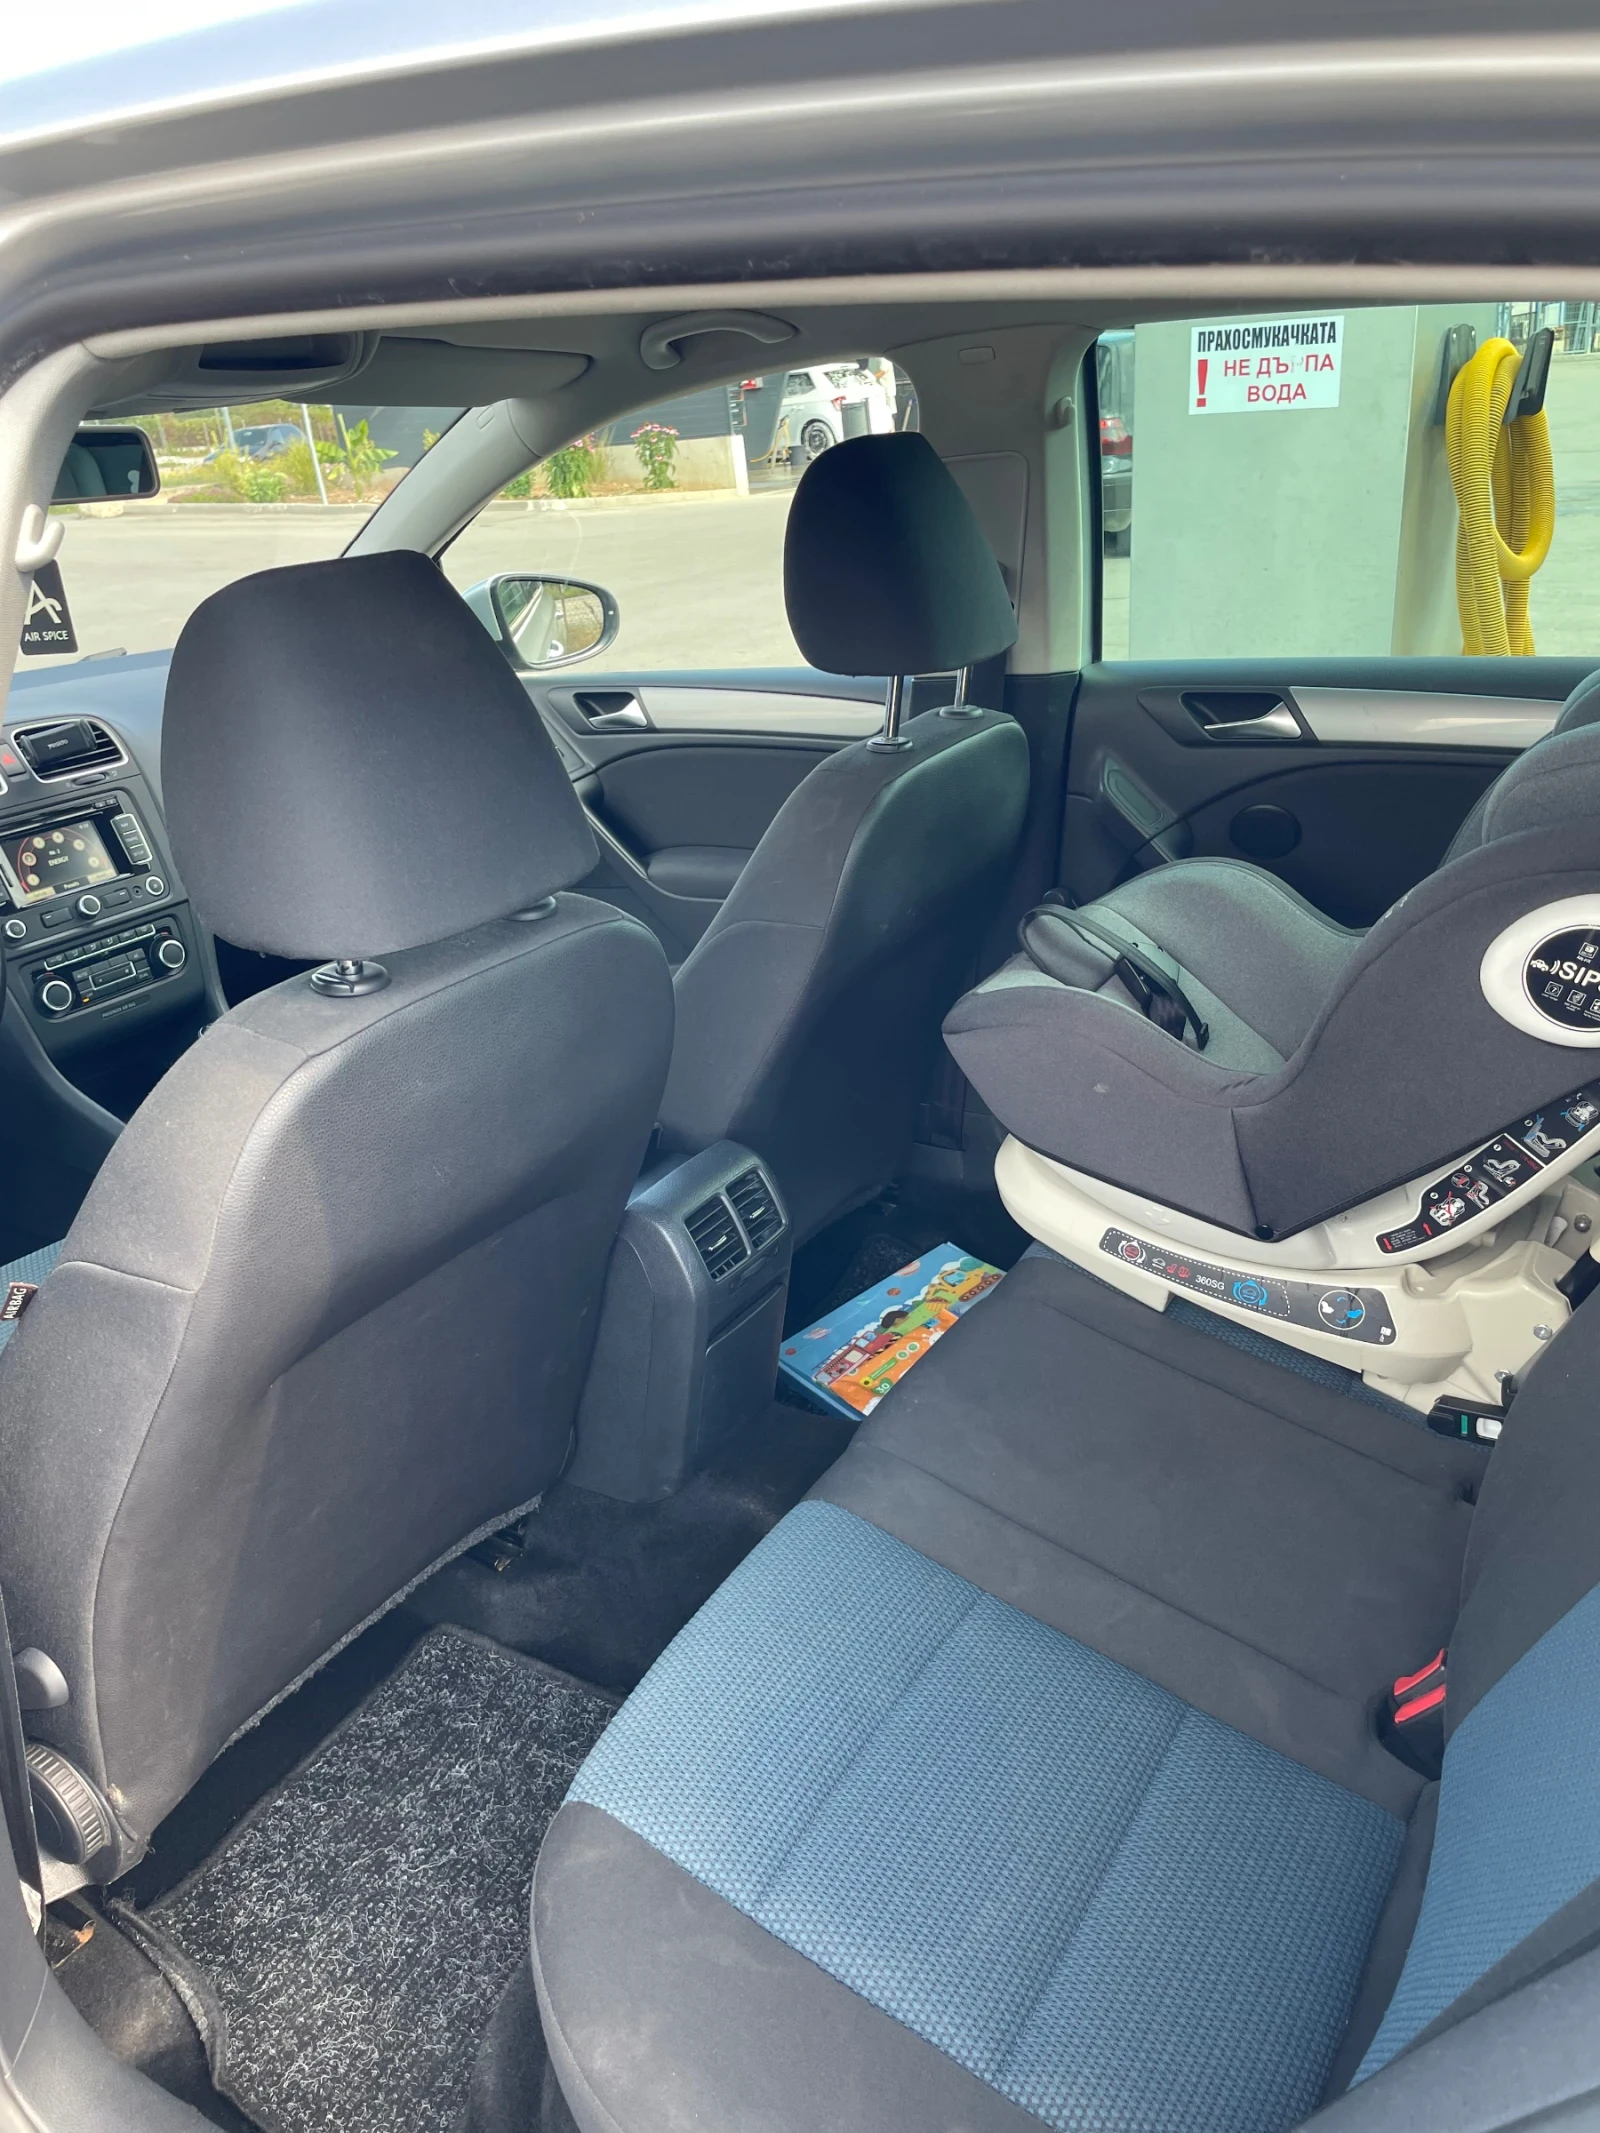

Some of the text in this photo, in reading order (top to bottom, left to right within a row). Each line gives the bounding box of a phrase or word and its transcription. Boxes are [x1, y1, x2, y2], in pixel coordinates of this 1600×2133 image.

[1197, 321, 1336, 352] ПРАХОСМУКАЧКАТА
[1224, 353, 1334, 378] НЕ ДЪПА
[1247, 383, 1307, 404] ВОДА
[24, 630, 69, 642] AIR SPICE
[1558, 961, 1600, 993] SIP
[1195, 1274, 1225, 1290] 360SG
[3, 1287, 27, 1319] AIRBAG
[876, 1382, 890, 1393] 30
